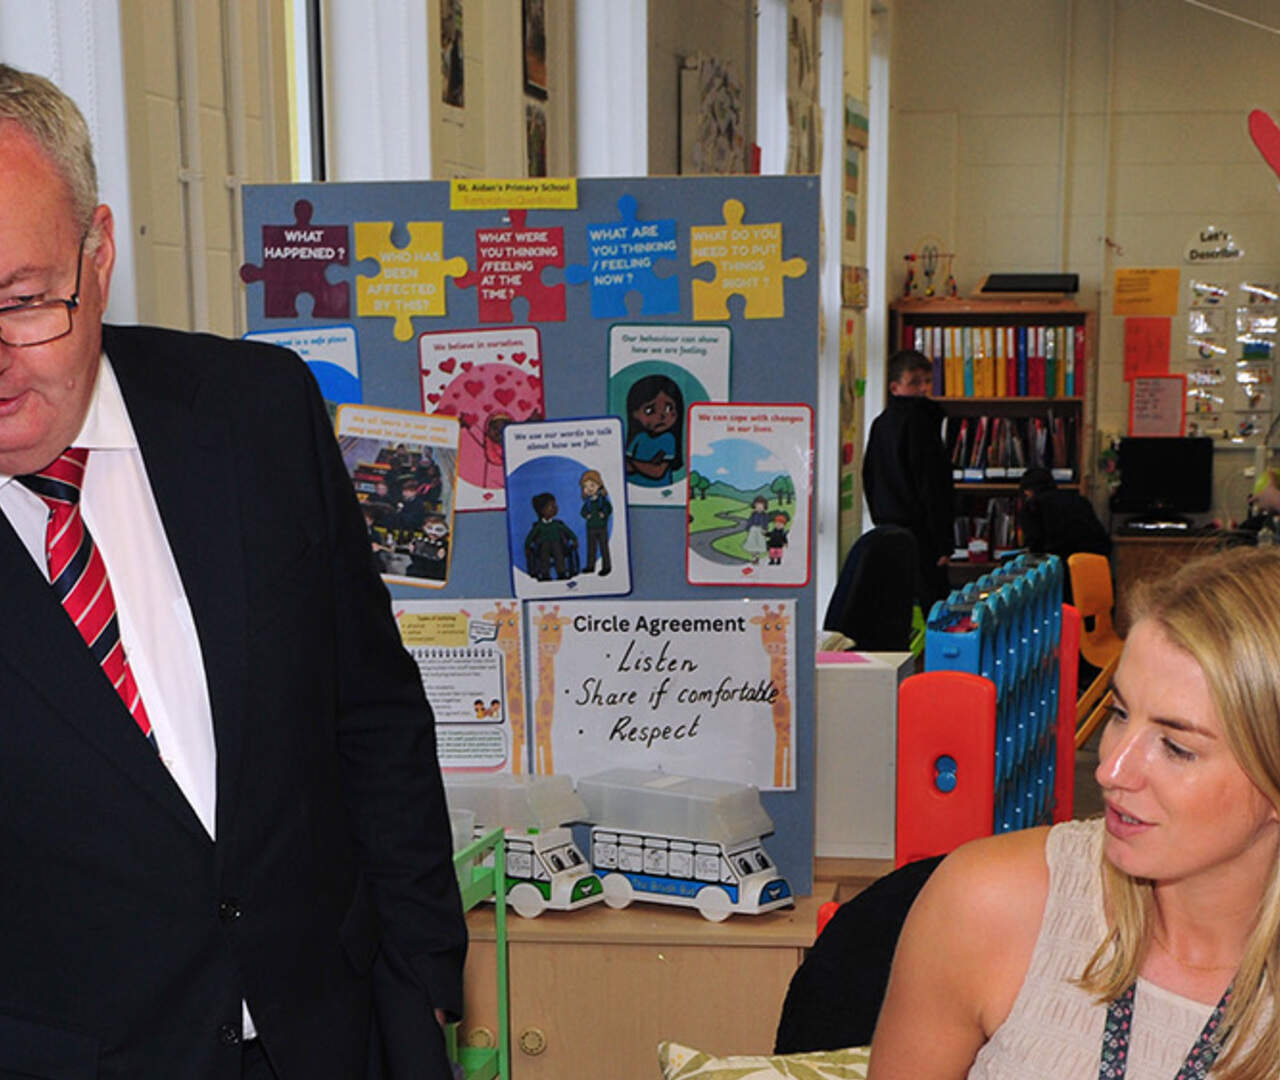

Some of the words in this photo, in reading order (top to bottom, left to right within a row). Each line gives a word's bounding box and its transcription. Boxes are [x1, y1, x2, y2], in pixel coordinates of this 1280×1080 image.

[471, 184, 503, 192] Aidan's
[505, 184, 538, 193] Primary
[542, 183, 570, 192] School
[284, 230, 324, 243] WHAT
[478, 232, 512, 243] WHAT
[515, 232, 548, 242] WERE
[590, 227, 629, 241] WHAT
[631, 225, 659, 238] ARE
[693, 230, 727, 241] WHAT
[731, 229, 750, 241] DO
[752, 228, 779, 240] YOU
[264, 247, 335, 260] HAPPENED
[480, 247, 505, 258] YOU
[507, 246, 558, 257] THINKING
[592, 244, 618, 257] YOU
[620, 240, 676, 254] THINKING
[693, 246, 729, 258] NEED
[732, 246, 749, 257] TO
[751, 244, 777, 256] PUT
[379, 252, 411, 263] WHO
[413, 251, 440, 262] HAS
[601, 257, 652, 270] FEELING
[721, 260, 765, 272] THINGS
[383, 267, 418, 279] BEEN
[481, 275, 496, 286] AT
[499, 274, 522, 285] THE
[594, 273, 626, 286] NOW
[722, 277, 758, 289] RIGHT
[367, 283, 436, 295] AFFECTED
[482, 289, 507, 300] TIME
[374, 300, 391, 311] BY
[622, 334, 637, 344] Our
[639, 333, 679, 344] behaviour
[681, 336, 696, 344] can
[699, 334, 719, 344] show
[448, 341, 475, 350] believe
[477, 340, 485, 349] in
[631, 345, 647, 355] how
[650, 347, 662, 355] we
[664, 347, 678, 355] are
[698, 413, 712, 422] We
[730, 414, 748, 424] cope
[751, 413, 768, 422] with
[770, 413, 804, 425] changes
[514, 432, 528, 441] We
[530, 433, 545, 441] use
[547, 432, 558, 440] our
[559, 429, 584, 439] words
[585, 430, 594, 438] to
[596, 427, 612, 437] talk
[726, 425, 734, 433] in
[526, 441, 550, 451] about
[552, 439, 569, 450] how
[571, 441, 582, 449] we
[573, 615, 630, 632] Circle
[635, 615, 746, 637] Agreement
[618, 639, 698, 673] Listen
[575, 677, 638, 706] Share
[648, 677, 671, 710] if
[677, 676, 780, 709] comfortable
[609, 714, 702, 748] Respect
